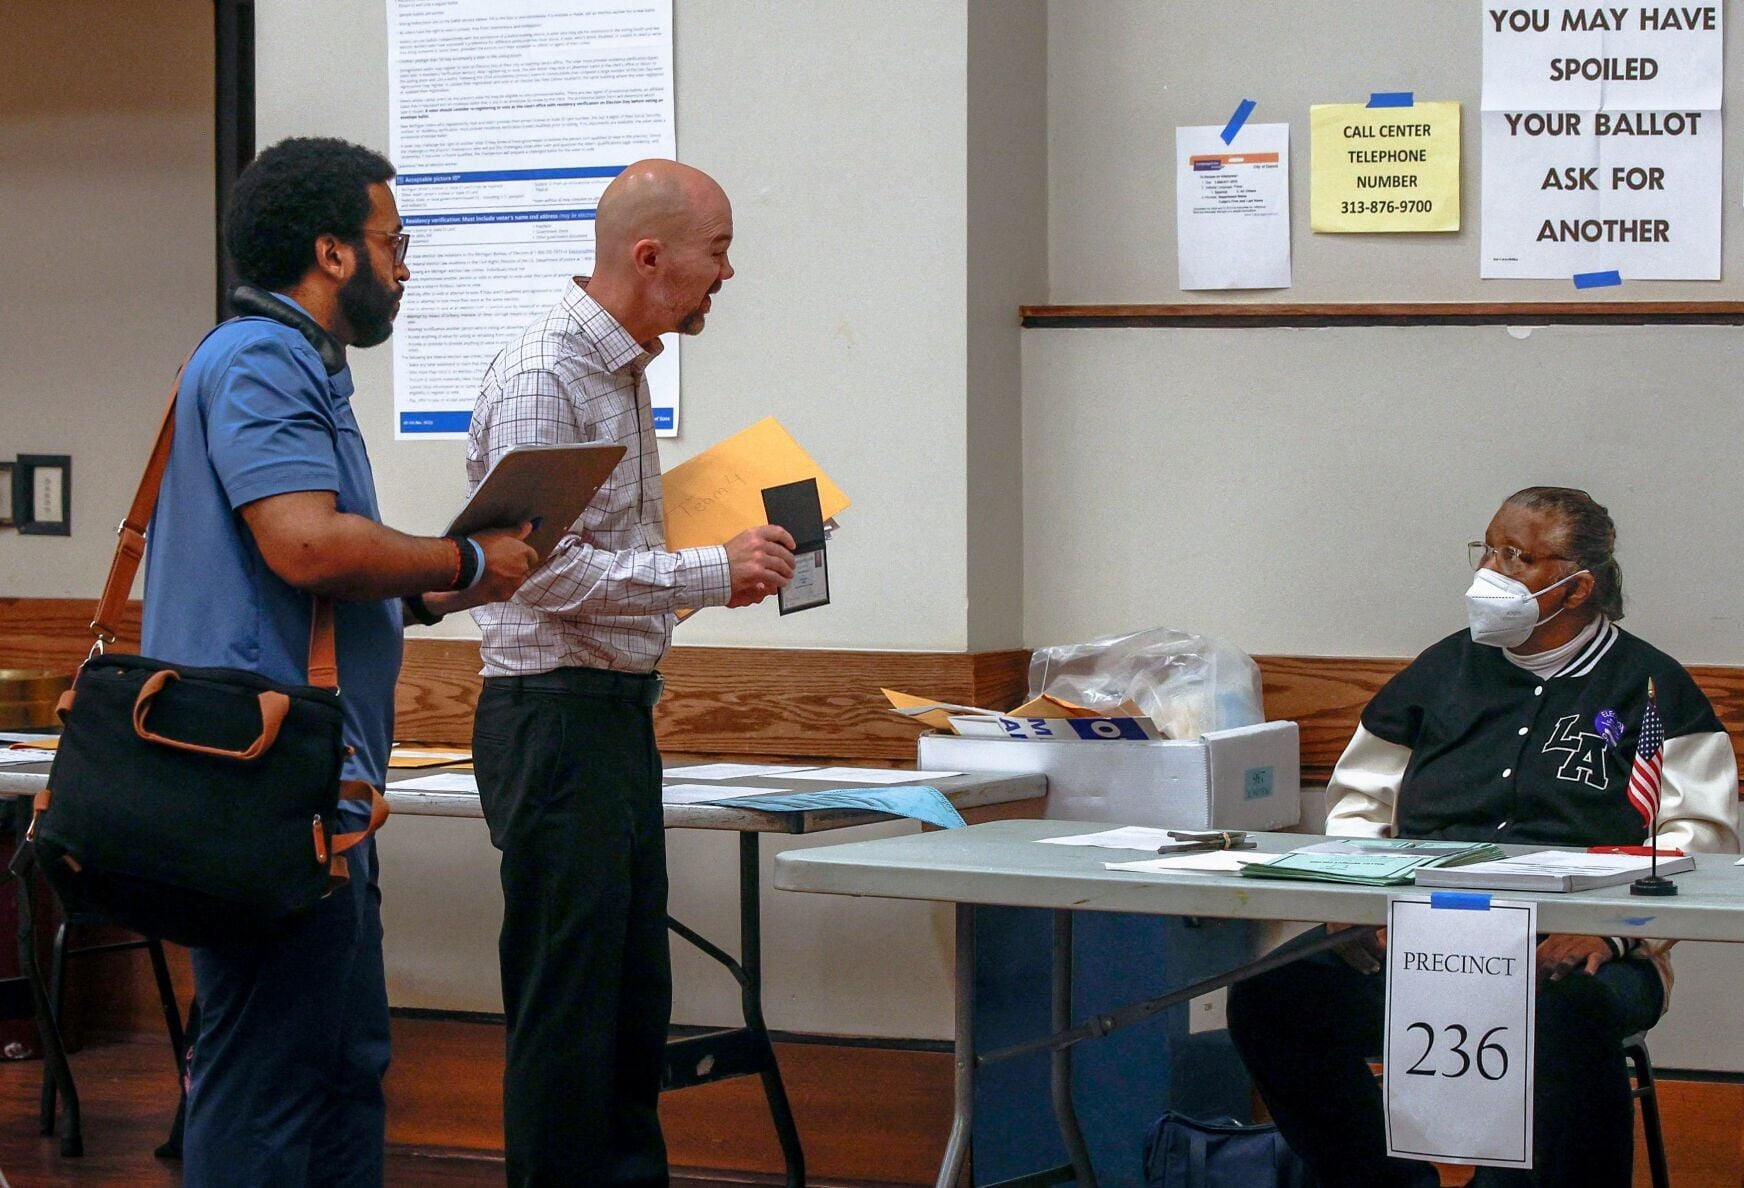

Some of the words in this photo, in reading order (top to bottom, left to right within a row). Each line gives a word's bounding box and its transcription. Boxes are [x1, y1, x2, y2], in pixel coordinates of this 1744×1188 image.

[1489, 8, 1550, 33] YOU
[1560, 7, 1629, 32] MAY
[1639, 6, 1717, 31] HAVE
[1549, 57, 1659, 82] SPOILED
[1343, 125, 1376, 139] CALL
[1378, 123, 1432, 138] CENTER
[1503, 112, 1582, 137] YOUR
[1594, 111, 1702, 136] BALLOT
[1347, 149, 1427, 164] TELEPHONE
[1356, 174, 1418, 189] NUMBER
[1540, 167, 1600, 191] ASK
[1611, 166, 1666, 190] FOR
[1340, 199, 1433, 214] 313-876-9700
[1535, 218, 1671, 243] ANOTHER
[1402, 951, 1517, 977] PRECINCT
[1405, 1021, 1510, 1081] 236
